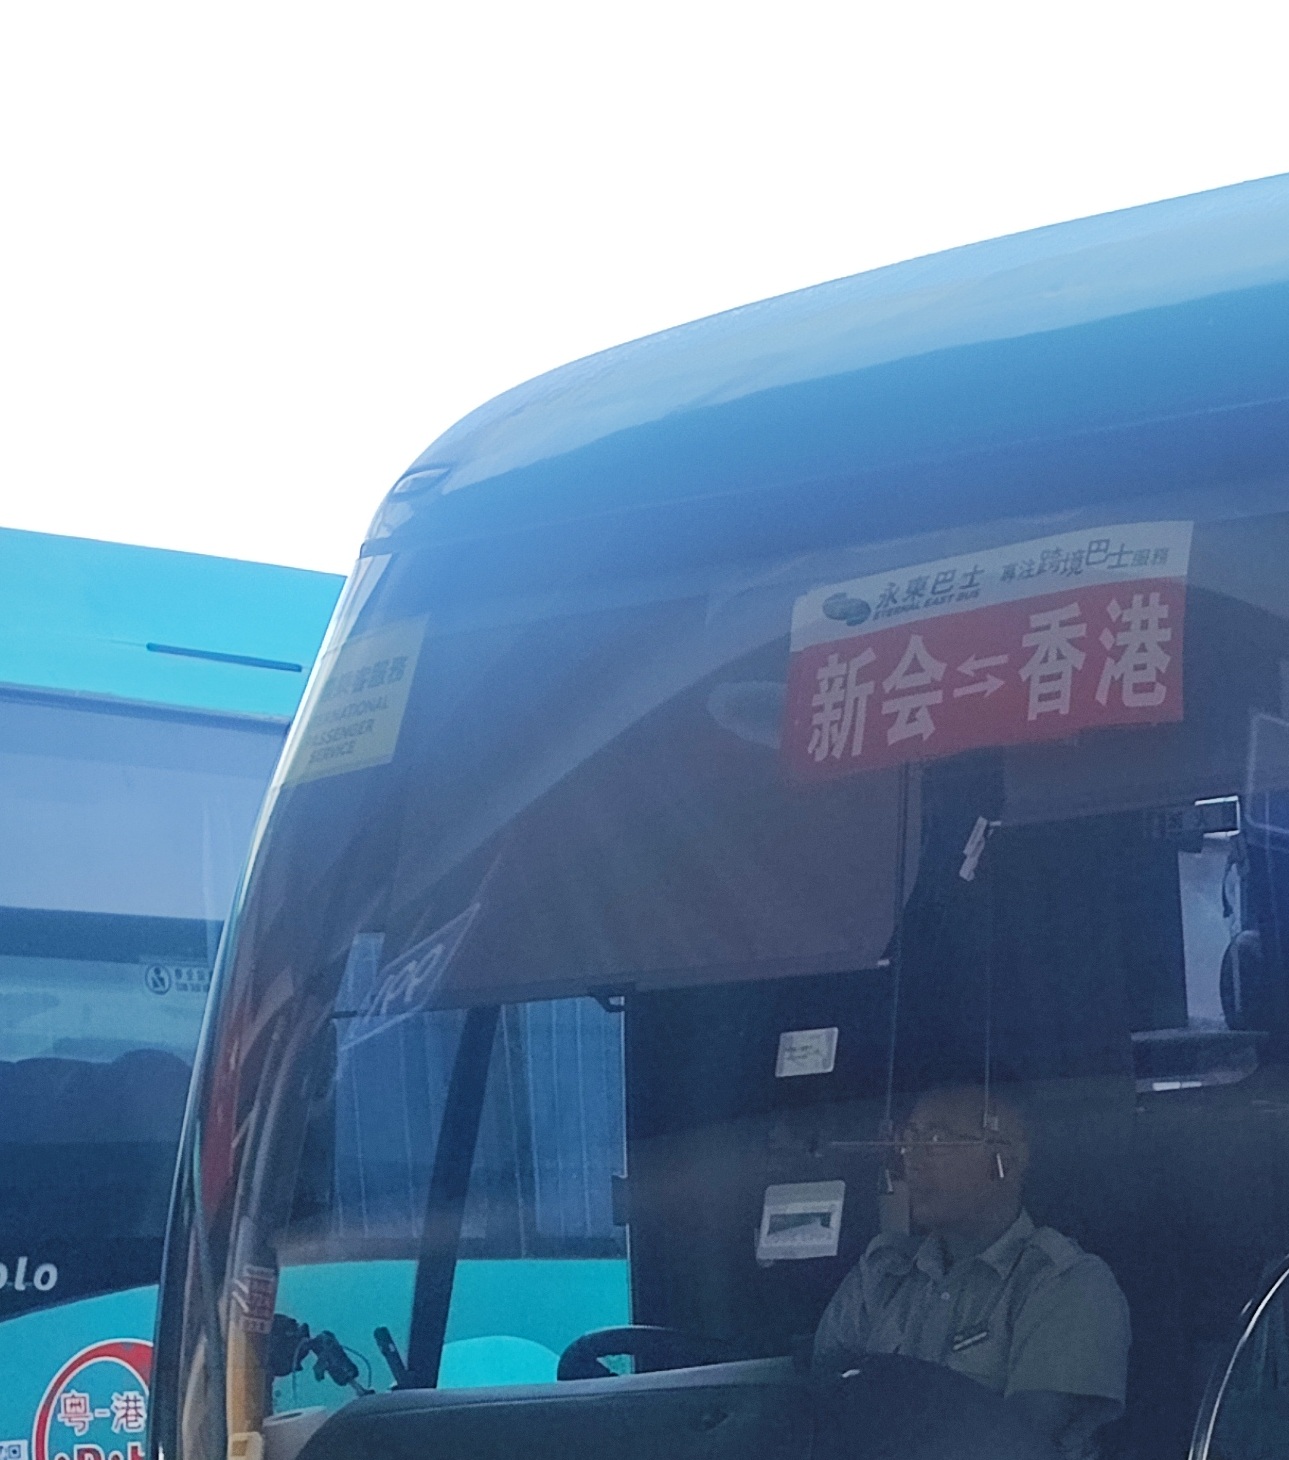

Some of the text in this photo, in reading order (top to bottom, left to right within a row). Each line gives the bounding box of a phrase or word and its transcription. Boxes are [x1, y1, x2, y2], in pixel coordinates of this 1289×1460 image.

[876, 564, 985, 609] 永東巴士
[955, 588, 981, 604] BUS
[806, 591, 1173, 763] 新会 香港
